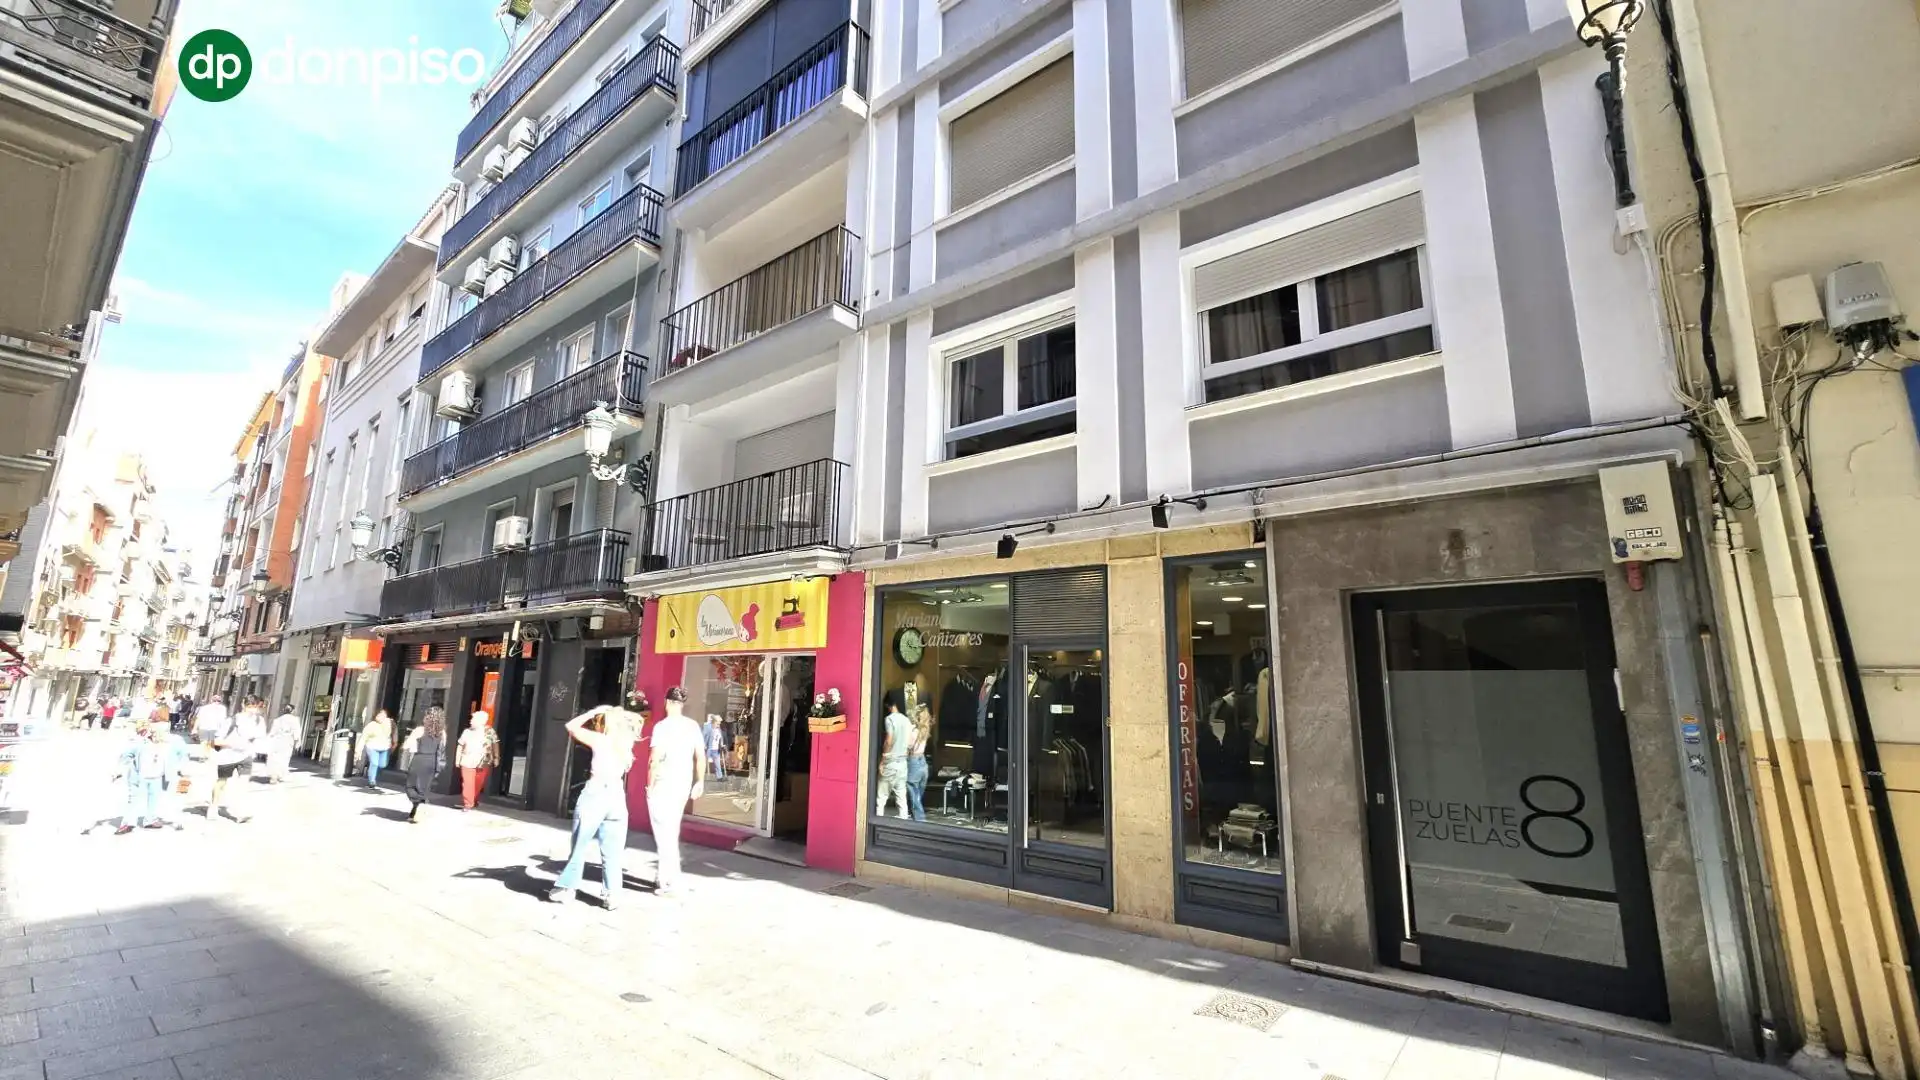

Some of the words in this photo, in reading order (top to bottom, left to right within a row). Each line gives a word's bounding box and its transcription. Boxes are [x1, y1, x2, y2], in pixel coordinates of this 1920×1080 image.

[918, 630, 983, 648] Cañizares
[1178, 661, 1194, 811] OFERTAS
[1408, 799, 1518, 827] PUENTE
[1519, 774, 1594, 859] 8
[1416, 820, 1521, 849] ZUELAS
